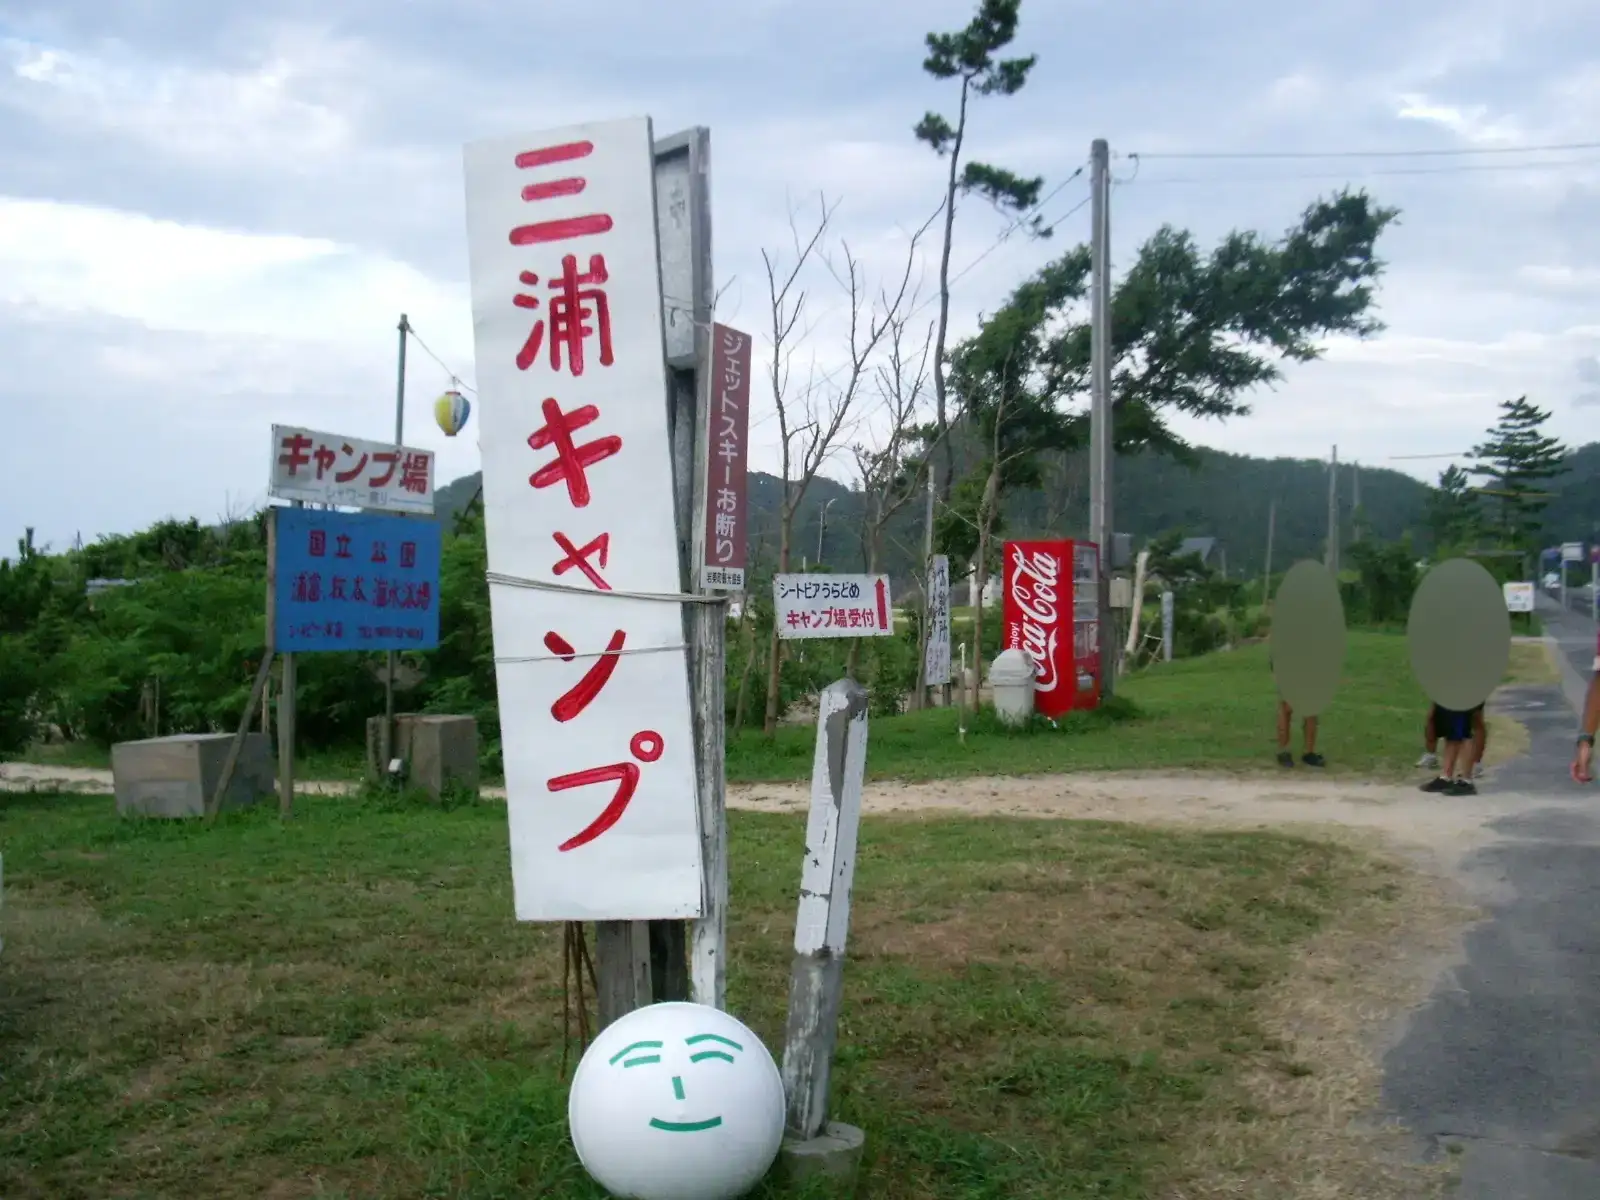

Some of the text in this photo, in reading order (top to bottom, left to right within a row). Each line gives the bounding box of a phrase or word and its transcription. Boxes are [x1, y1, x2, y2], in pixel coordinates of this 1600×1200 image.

[279, 434, 429, 494] キャンプ場
[715, 332, 742, 562] ジェットスキーお断り
[508, 140, 665, 853] 三浦キャンプ
[780, 581, 860, 599] シートピアうらどめ
[787, 606, 875, 629] キャンプ場受付
